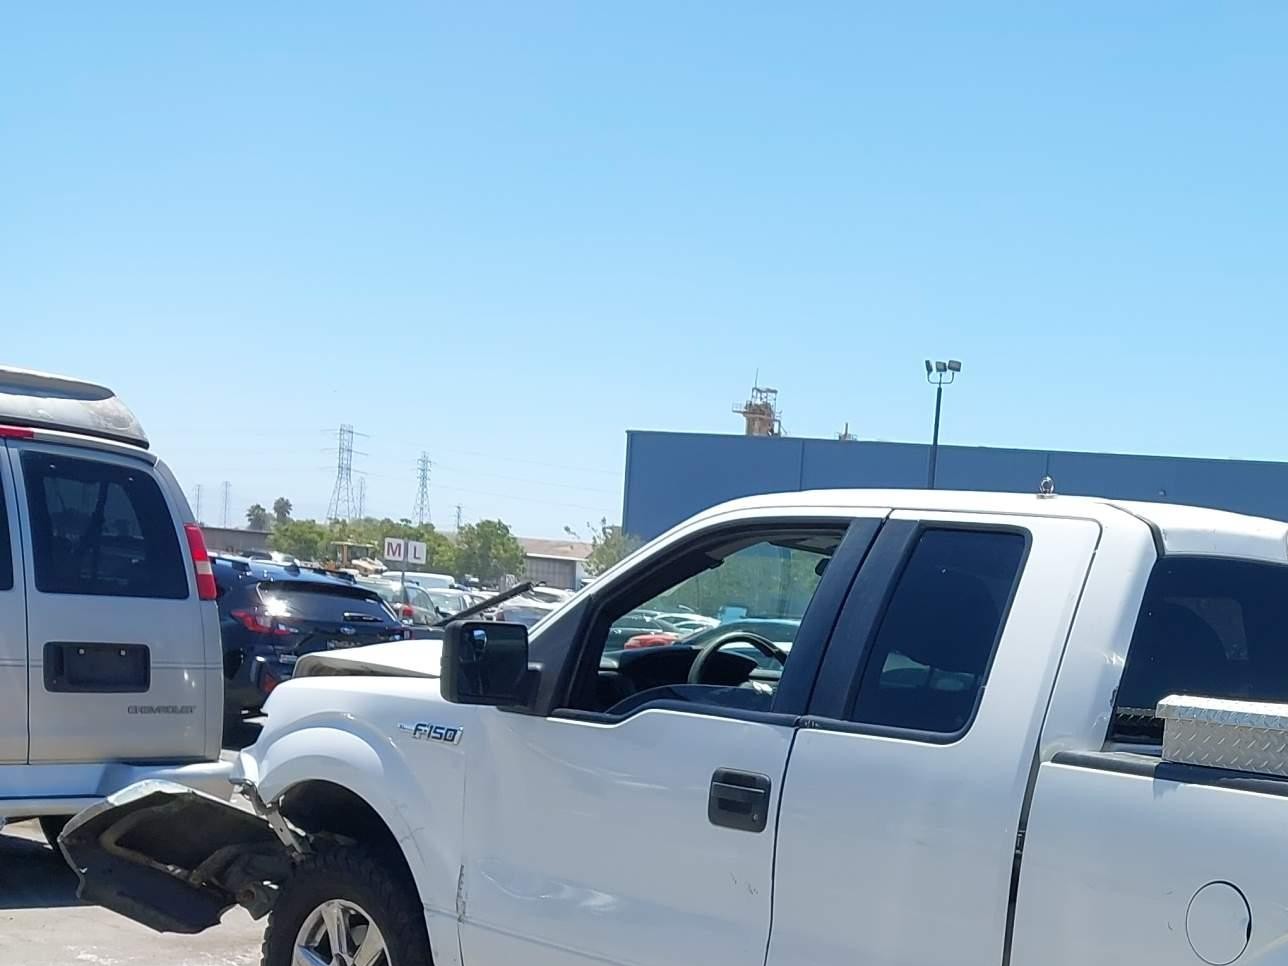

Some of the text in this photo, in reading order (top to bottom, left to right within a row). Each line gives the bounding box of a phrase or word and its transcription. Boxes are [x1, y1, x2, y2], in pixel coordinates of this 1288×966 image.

[387, 542, 422, 560] M L
[412, 723, 459, 742] F-150
